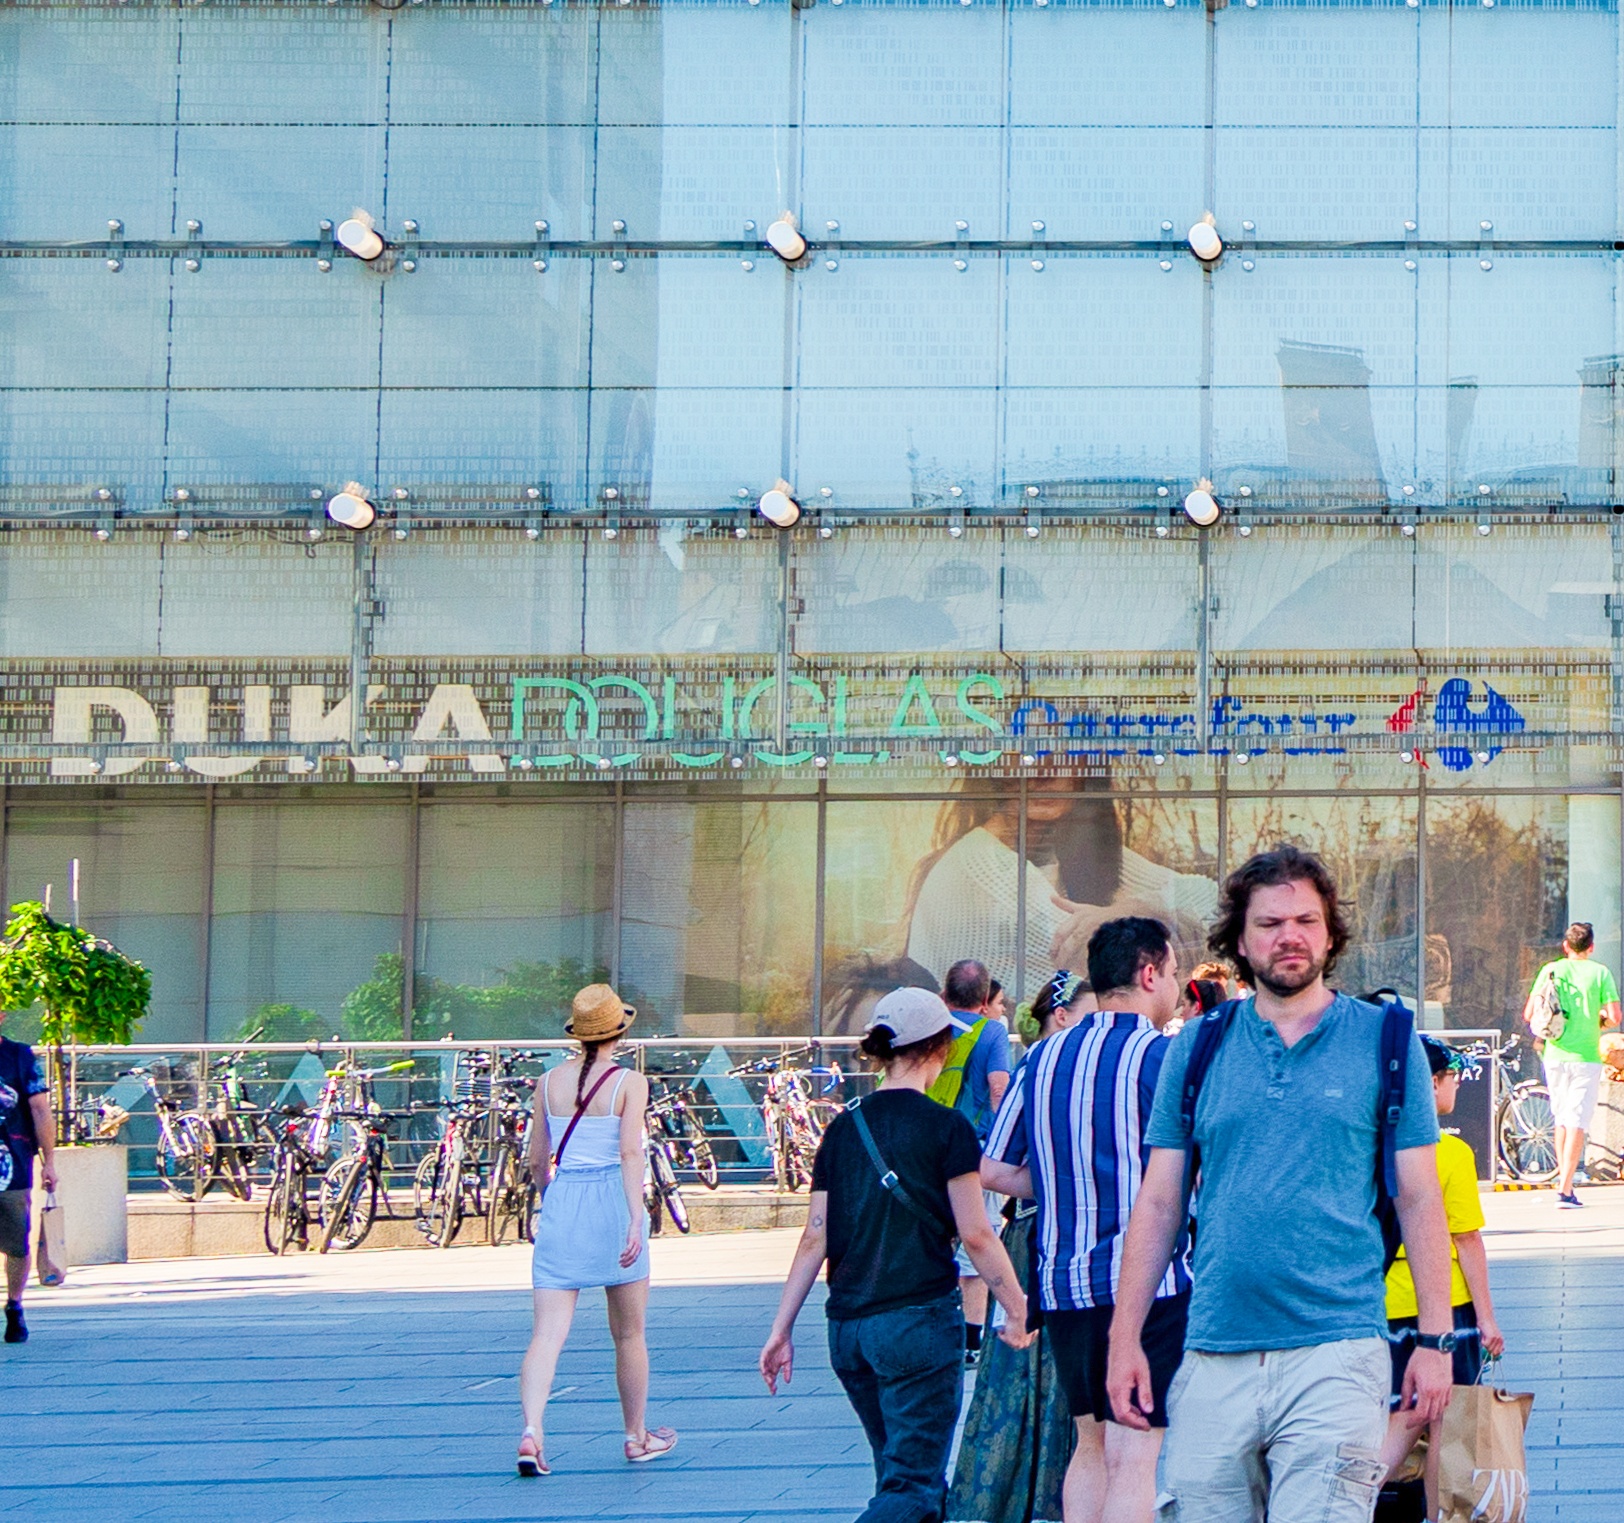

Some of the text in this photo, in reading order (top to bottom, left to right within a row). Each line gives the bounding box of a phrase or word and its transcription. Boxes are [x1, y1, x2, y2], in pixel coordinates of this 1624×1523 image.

[50, 684, 505, 776] DUKA
[511, 673, 1005, 769] DOUGLAS
[1008, 695, 1356, 758] Carrefour
